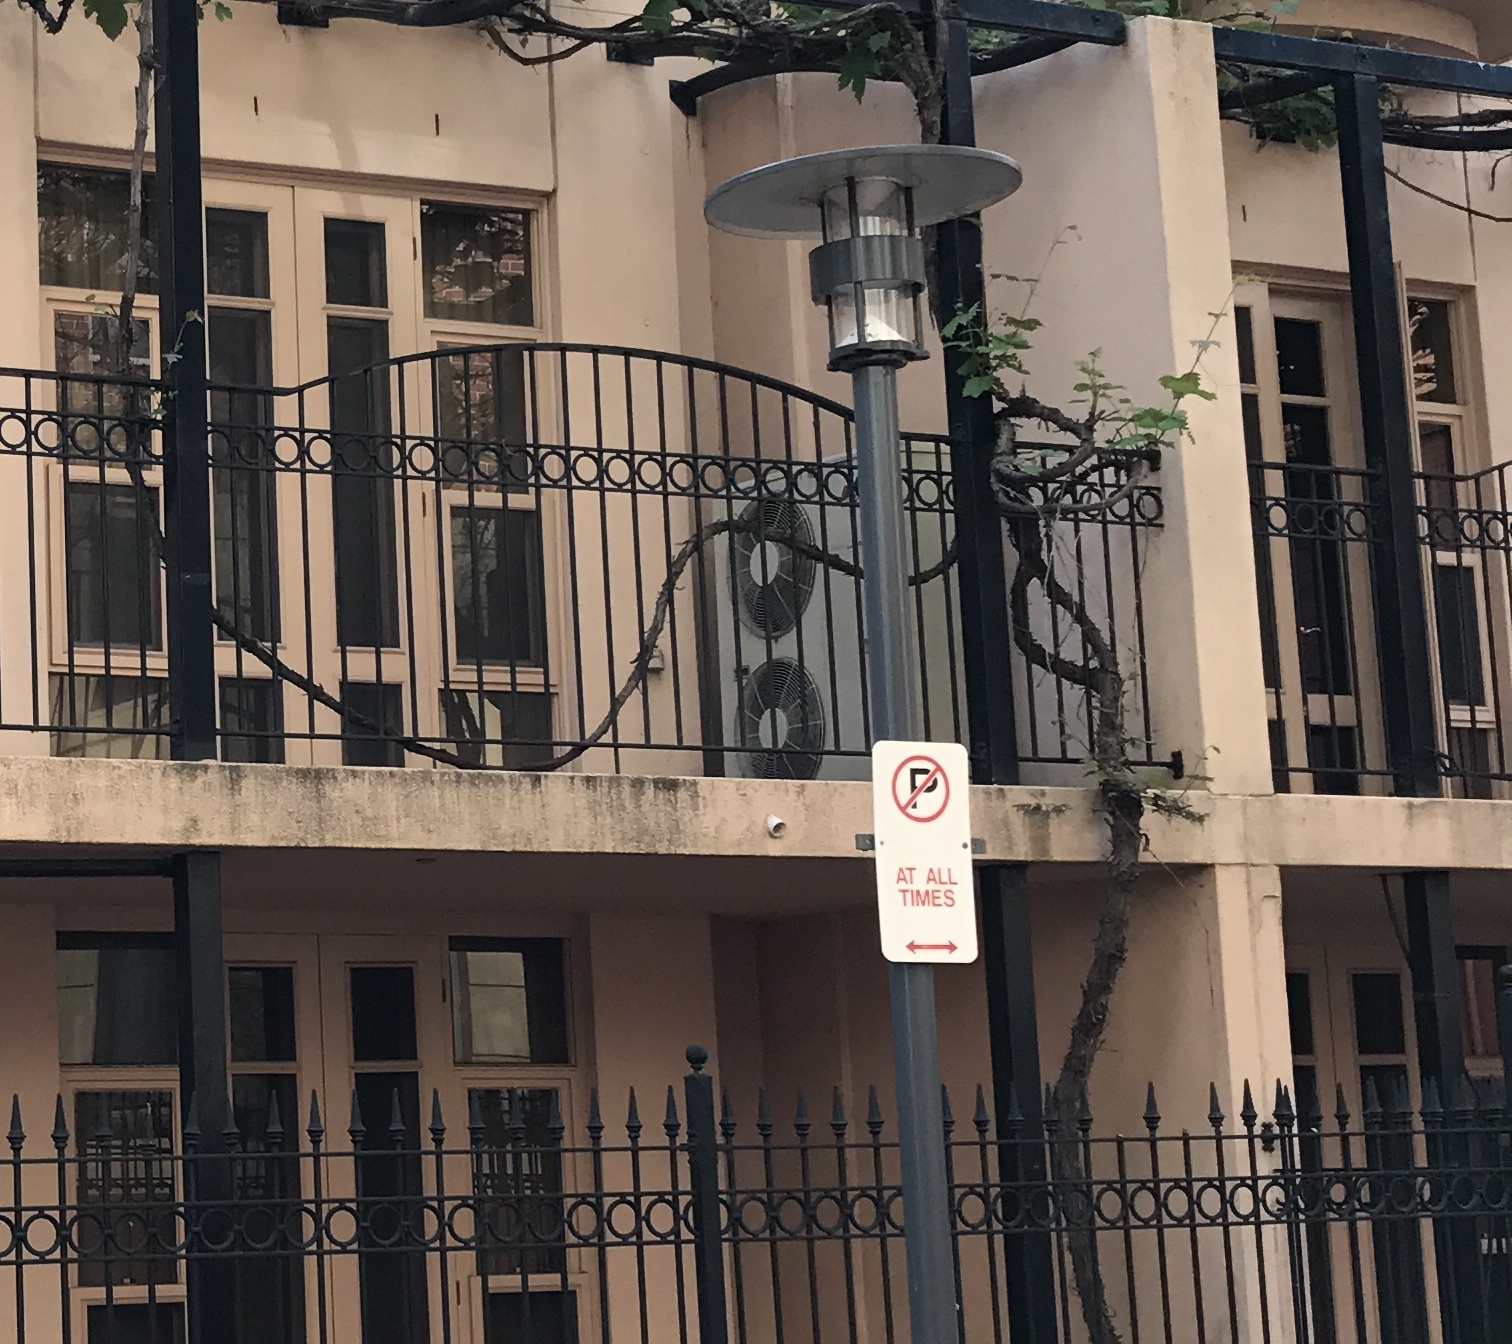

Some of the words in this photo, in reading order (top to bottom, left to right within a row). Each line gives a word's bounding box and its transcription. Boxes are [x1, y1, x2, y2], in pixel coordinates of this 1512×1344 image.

[909, 767, 939, 809] P
[896, 867, 916, 884] AT
[926, 868, 958, 885] ALL
[898, 889, 956, 907] TIMES
